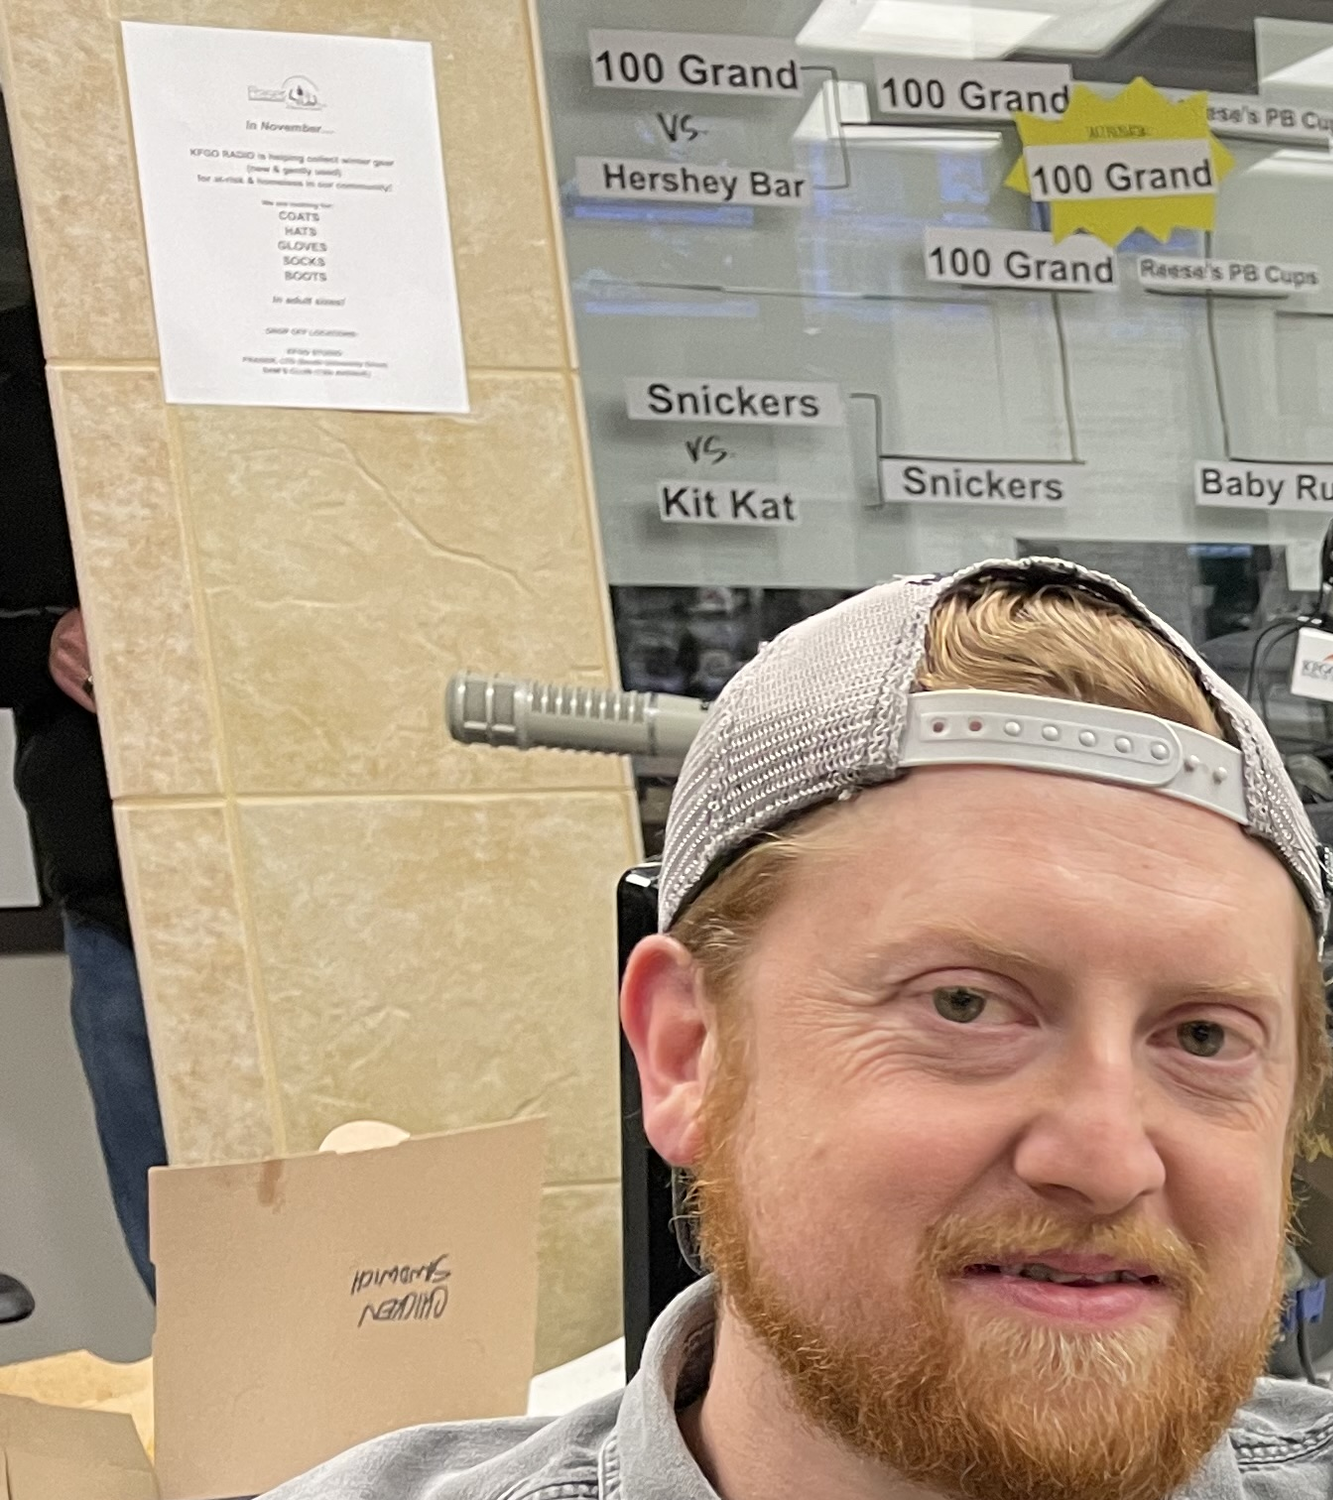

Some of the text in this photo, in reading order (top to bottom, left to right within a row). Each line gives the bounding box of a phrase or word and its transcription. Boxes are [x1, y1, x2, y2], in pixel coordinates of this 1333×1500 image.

[596, 49, 798, 90] 100 Grand
[882, 77, 1070, 114] 100 Grand
[1266, 109, 1295, 128] PB
[603, 163, 805, 201] Hershey Bar
[1033, 158, 1213, 196] 100 Grand
[278, 210, 320, 222] COATS
[284, 226, 318, 237] HATS
[277, 240, 328, 252] GLOVES
[283, 256, 326, 267] SOCKS
[284, 271, 328, 282] BOOTS
[930, 246, 1114, 284] 100 Grand
[1140, 258, 1320, 290] Reese's PB Cups
[647, 382, 820, 418] Snickers
[902, 466, 1064, 500] Snickers
[1201, 468, 1285, 506] Baby
[663, 486, 796, 521] Kit Kat
[357, 1284, 449, 1328] CHICKEN
